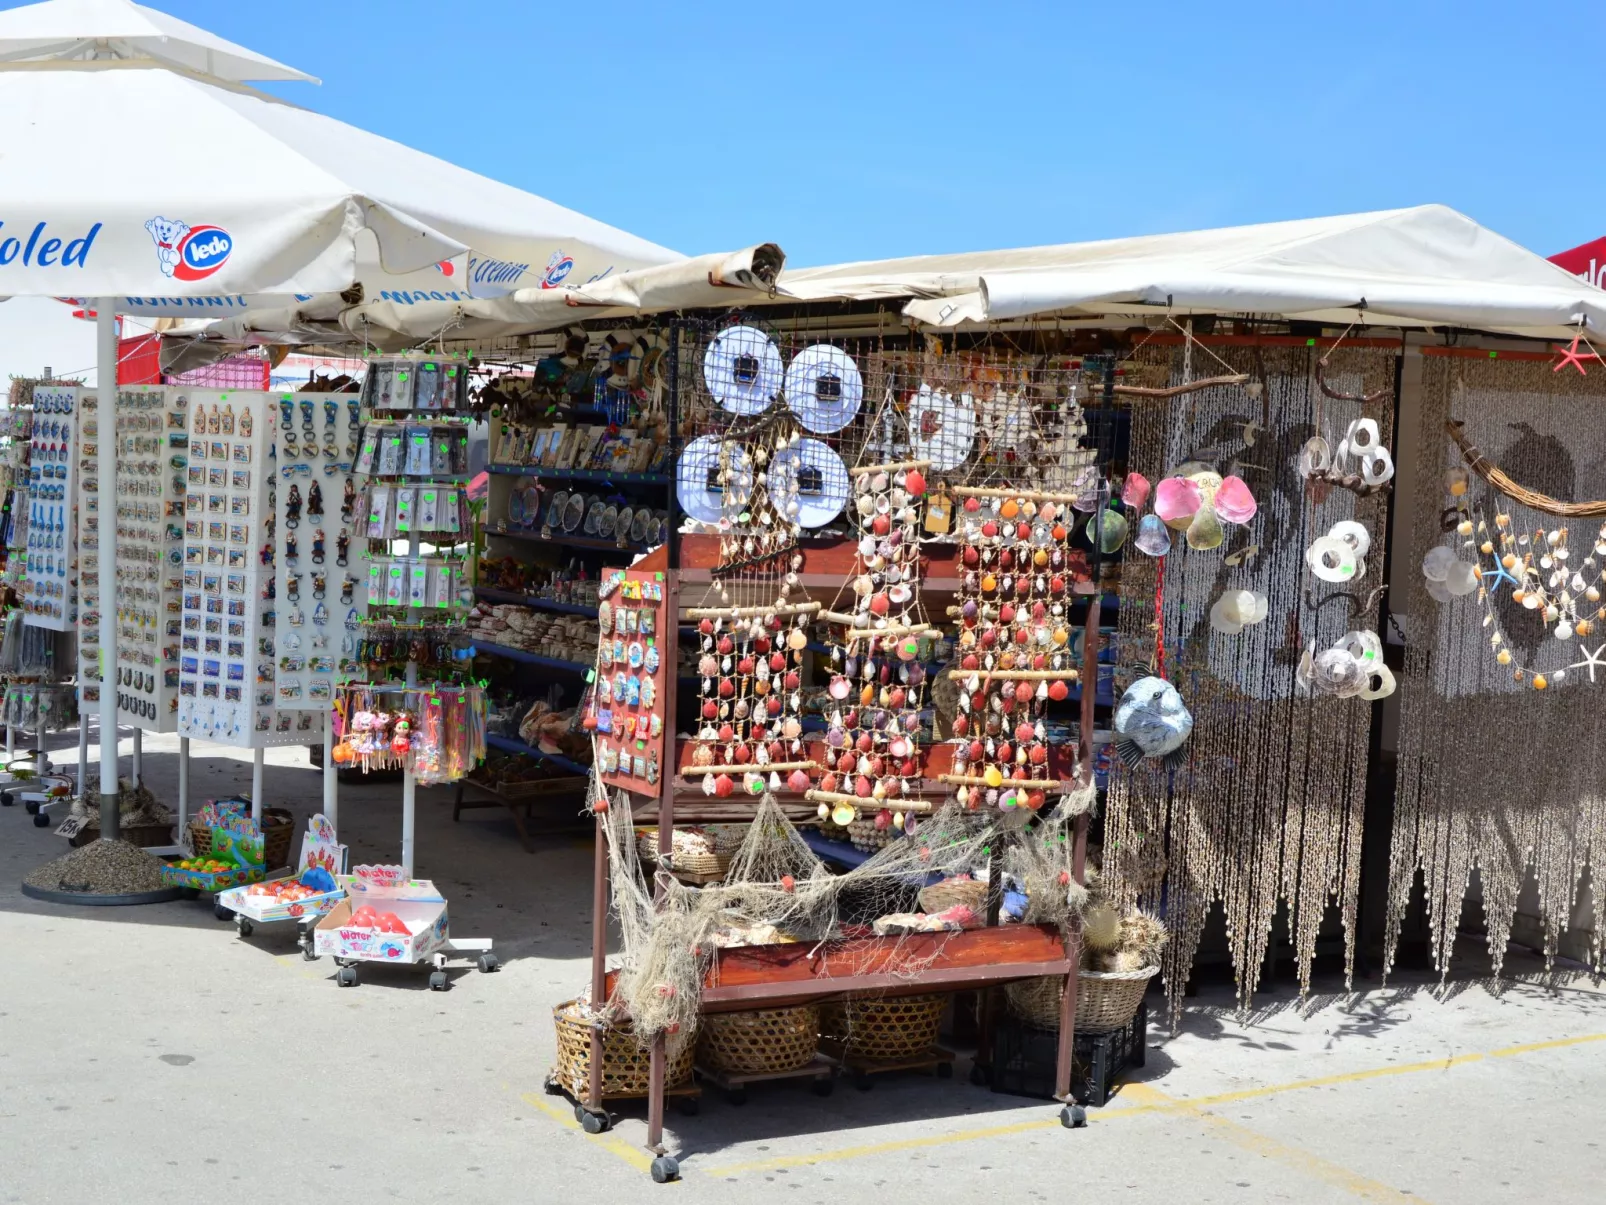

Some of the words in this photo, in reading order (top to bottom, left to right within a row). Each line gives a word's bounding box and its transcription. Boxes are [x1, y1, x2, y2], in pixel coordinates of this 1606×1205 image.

[0, 221, 103, 268] oled
[190, 236, 230, 262] ledo
[340, 930, 372, 941] Water
